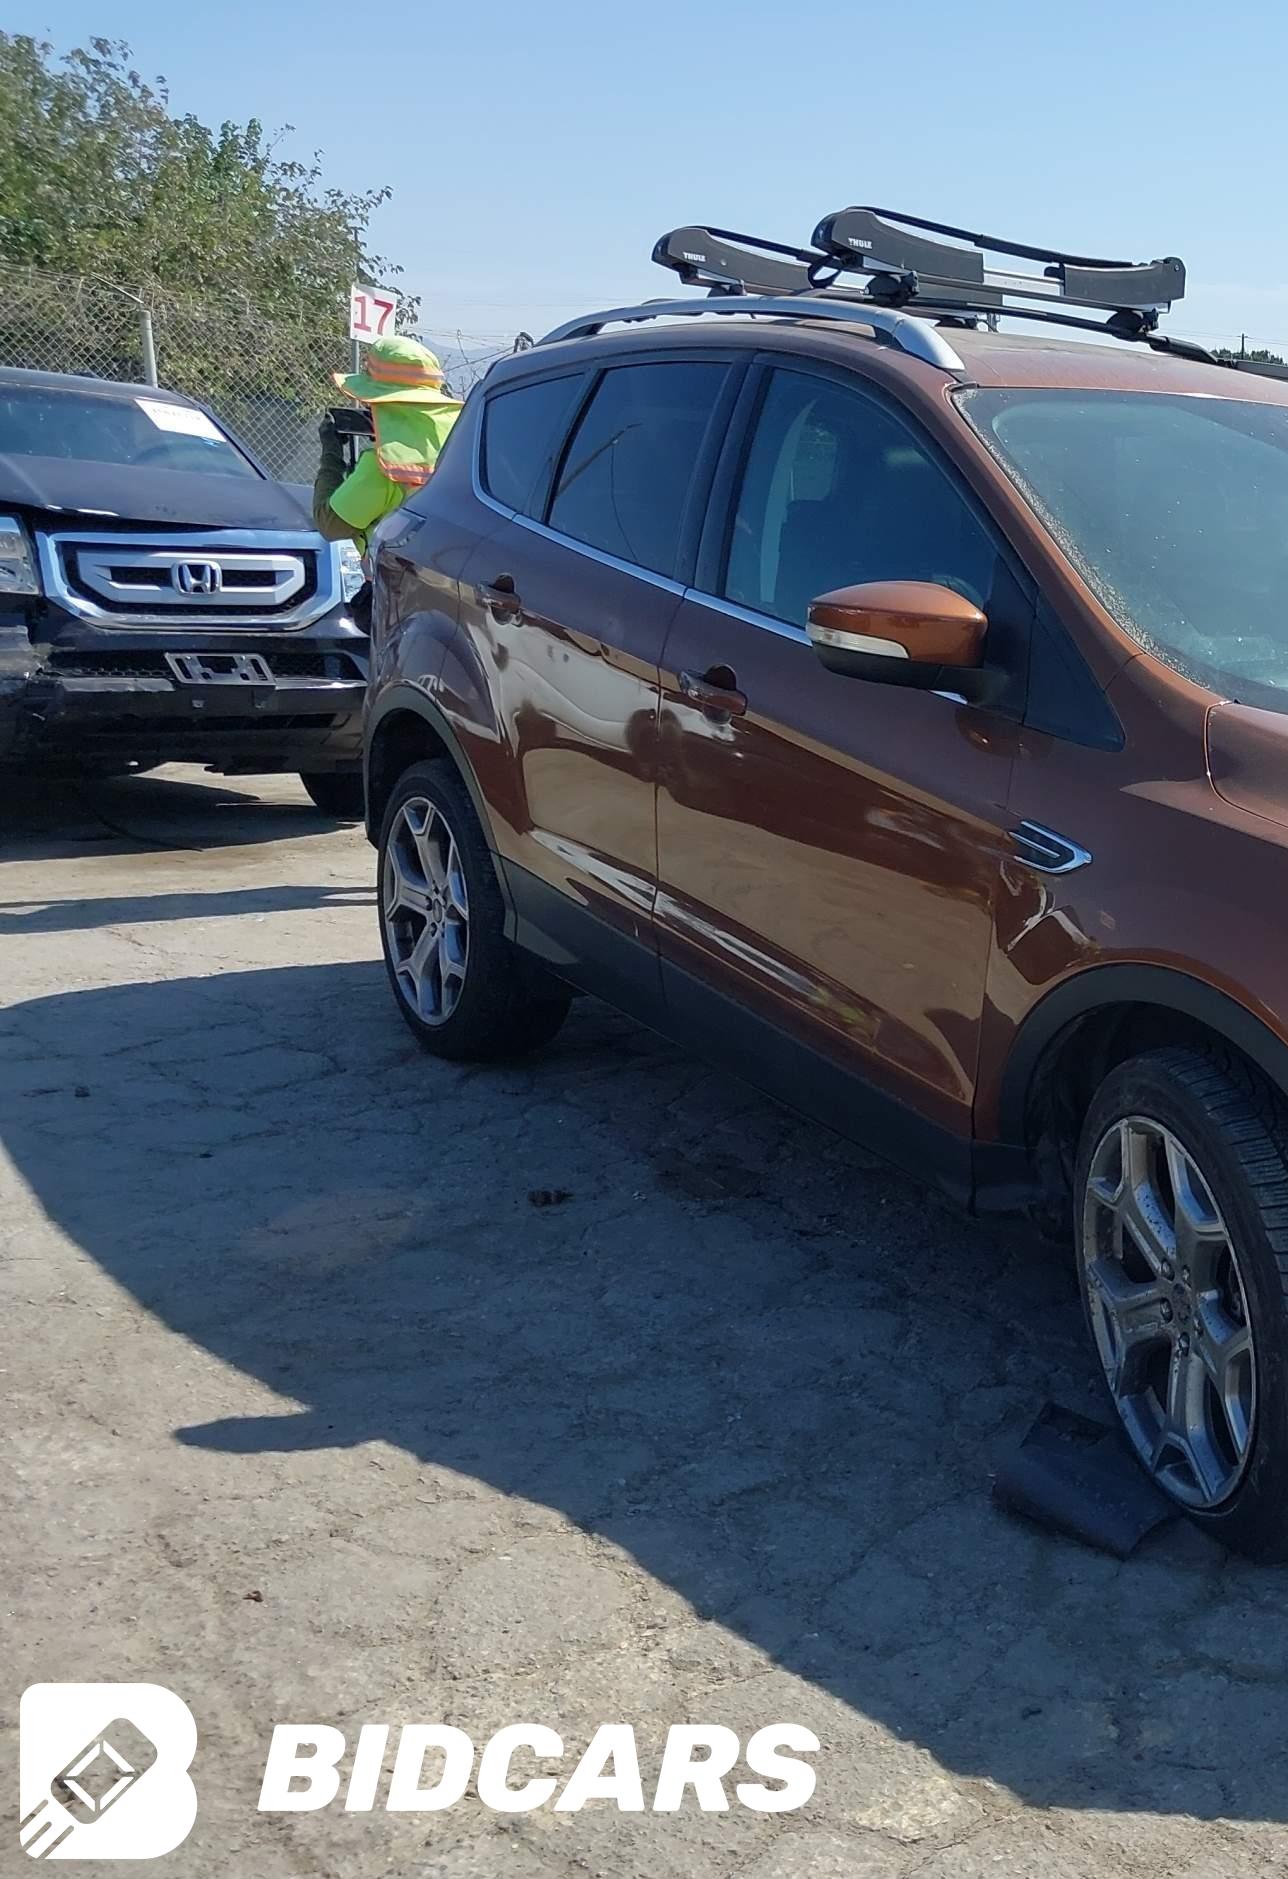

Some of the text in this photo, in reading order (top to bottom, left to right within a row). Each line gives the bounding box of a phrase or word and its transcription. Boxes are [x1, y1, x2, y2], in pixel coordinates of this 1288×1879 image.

[848, 237, 873, 249] THULE
[683, 252, 706, 262] THULE
[354, 296, 394, 336] 17
